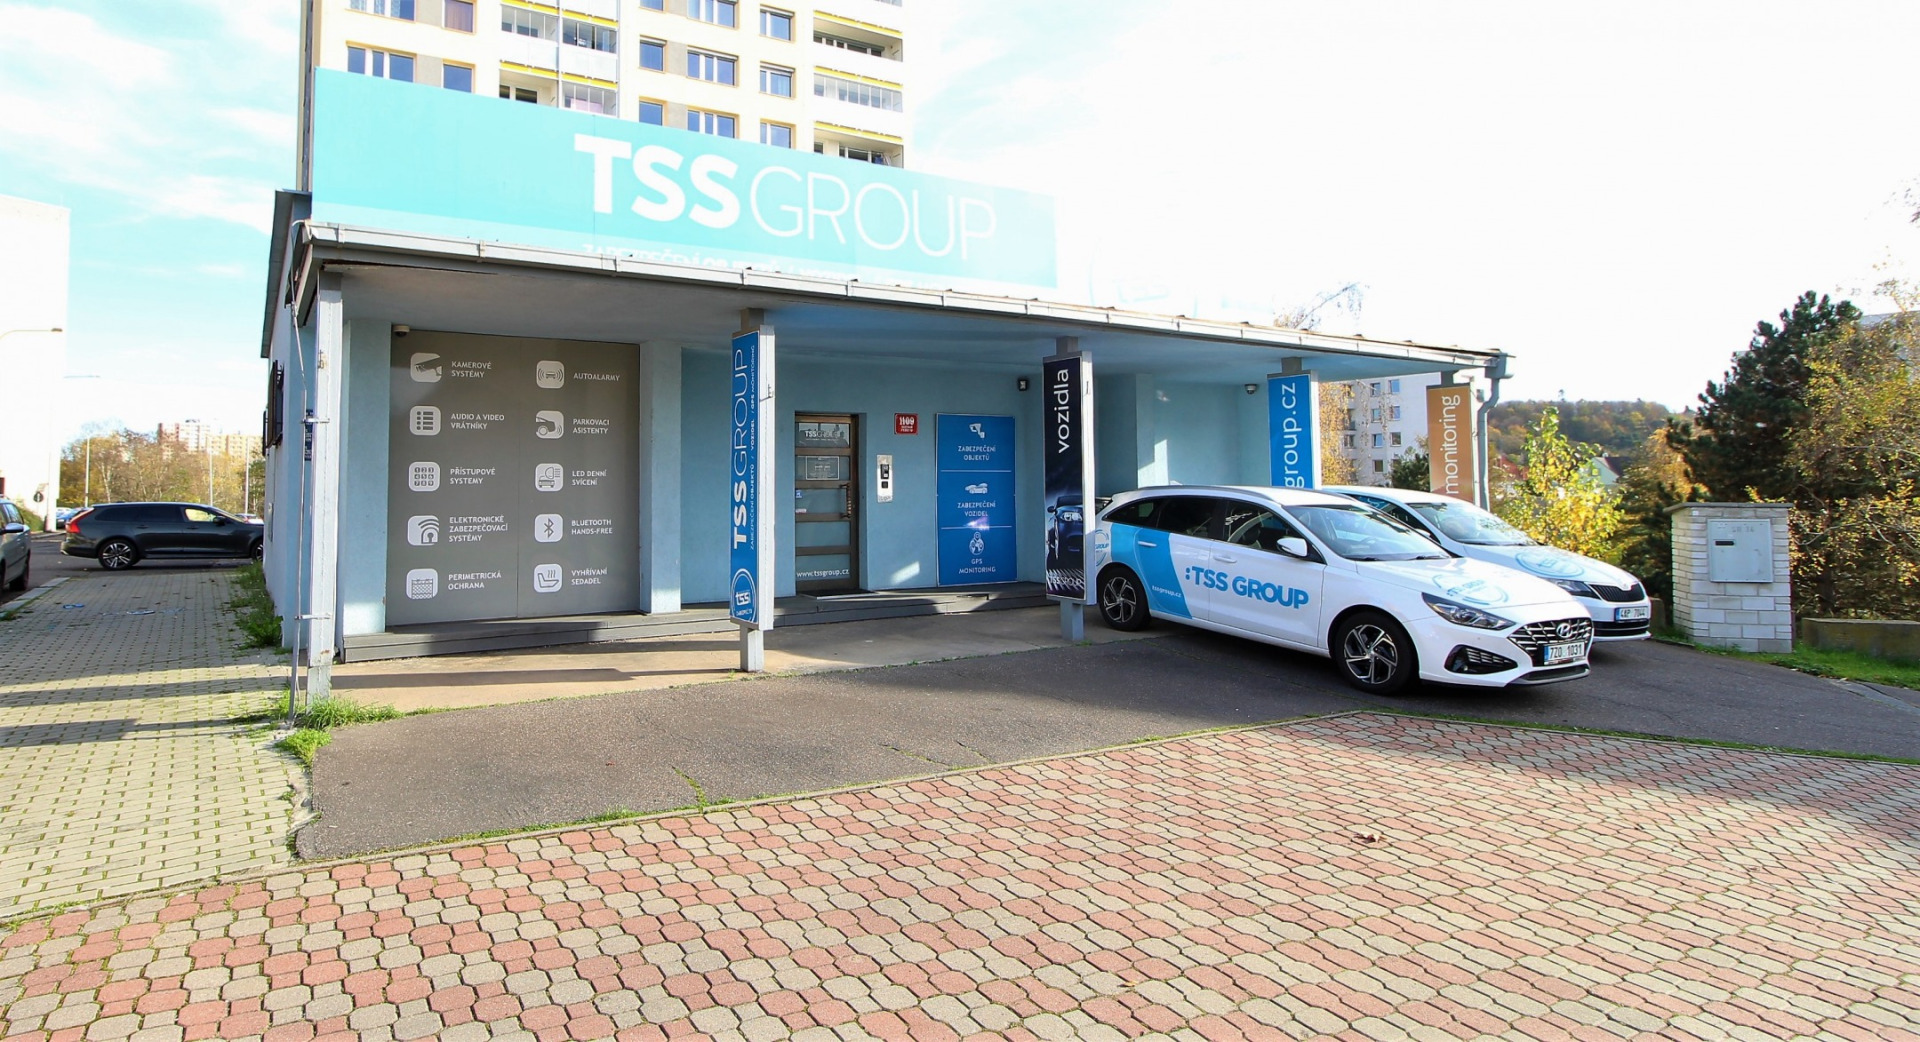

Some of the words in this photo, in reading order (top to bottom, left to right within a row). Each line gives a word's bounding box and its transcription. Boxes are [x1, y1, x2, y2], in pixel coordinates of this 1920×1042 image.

[451, 360, 492, 370] KAMEROVÉ
[451, 369, 485, 378] SYSTÉMY
[573, 372, 621, 382] AUTOALARMY
[1054, 369, 1070, 453] vozidla
[482, 413, 506, 421] VIDEO
[450, 421, 488, 430] VRÁTNÍKY
[572, 426, 609, 434] ASISTENTY
[957, 444, 996, 452] ZABEZPEČENÍ
[1441, 394, 1461, 494] monitoring
[963, 453, 990, 461] OBJEKTŮ
[449, 466, 496, 475] PŘÍSTUPOVÉ
[586, 469, 608, 477] DENNÍ
[571, 478, 598, 486] SVÍCENÍ
[957, 500, 996, 509] ZABEZPEČENÍ
[571, 519, 612, 527] BLUETOOTH
[448, 523, 508, 533] ZABEZPEČOVACÍ
[571, 527, 613, 535] HANDS-FREE
[448, 533, 483, 543] SYSTÉMY
[796, 568, 850, 578] www.tssgroup.cz
[958, 566, 996, 575] MONITORING
[448, 570, 502, 581] PERIMETRICKÁ
[447, 581, 485, 591] OCHRANA
[571, 577, 602, 586] SEDADEL
[1232, 575, 1310, 610] GROUP
[1567, 643, 1582, 656] 1031
